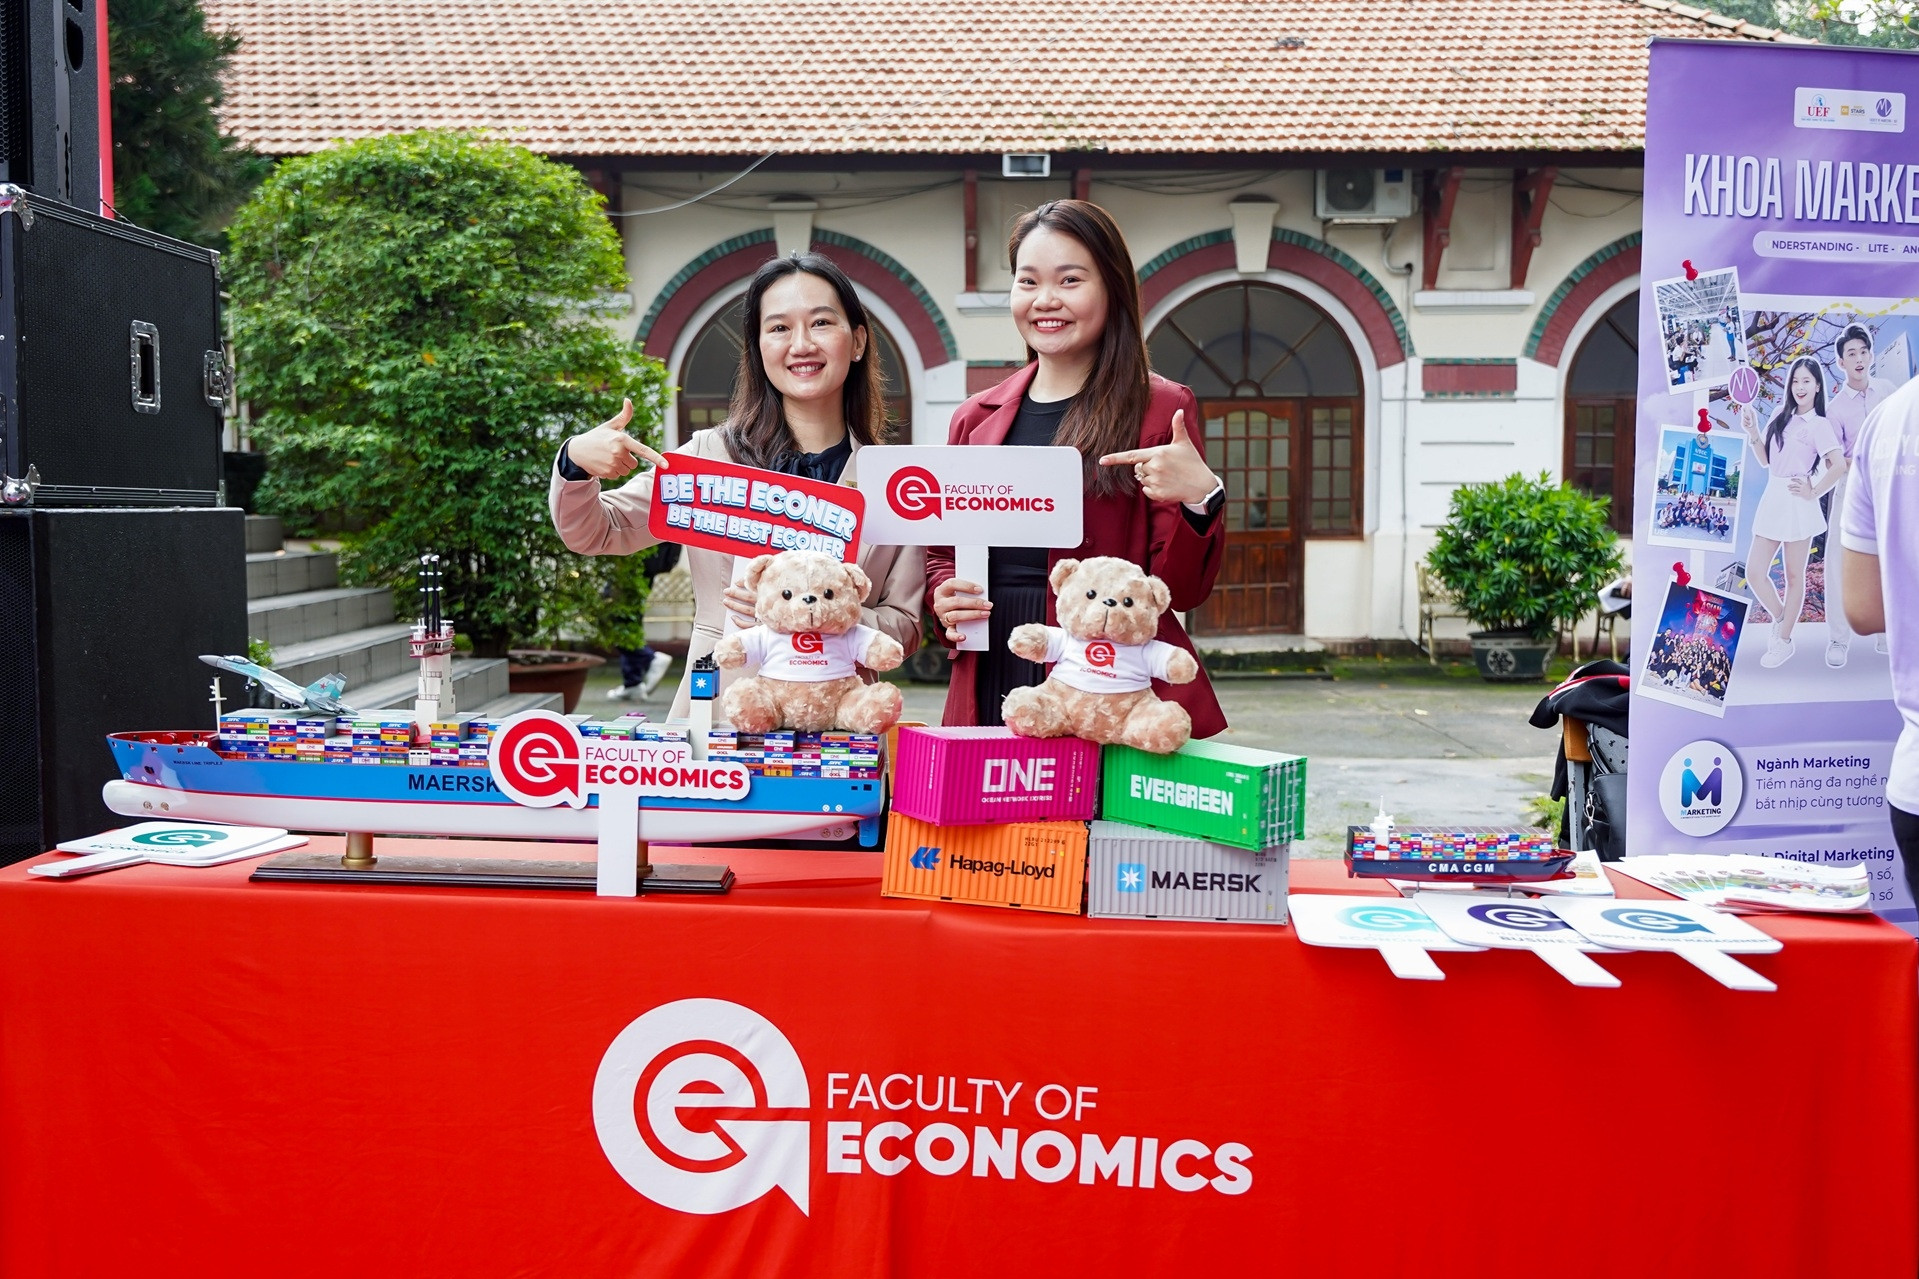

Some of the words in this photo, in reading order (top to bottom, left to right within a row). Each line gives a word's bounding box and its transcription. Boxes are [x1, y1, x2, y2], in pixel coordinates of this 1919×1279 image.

[1808, 106, 1830, 117] UEF
[1683, 153, 1784, 219] KHOA
[945, 484, 994, 495] FACULTY
[997, 485, 1014, 495] OF
[660, 473, 694, 503] BE
[697, 474, 748, 507] THE
[750, 480, 857, 542] ECONER
[946, 497, 1055, 512] ECONOMICS
[666, 504, 692, 528] BE
[692, 508, 728, 536] THE
[727, 516, 772, 545] BEST
[771, 525, 846, 562] ECONER
[586, 747, 658, 763] FACULTY
[662, 750, 686, 764] OF
[1756, 757, 1799, 772] Ngành
[1803, 755, 1870, 770] Marketing
[408, 774, 503, 795] MAERSK
[585, 764, 744, 790] ECONOMICS
[982, 758, 1056, 792] ONE
[1756, 777, 1786, 790] Tiềm
[1790, 777, 1822, 791] năng
[1825, 776, 1841, 788] đa
[1846, 774, 1878, 788] nghề
[1130, 774, 1234, 816] EVERGREEN
[1755, 798, 1776, 810] bắt
[1778, 796, 1806, 813] nhịp
[1810, 796, 1843, 810] cùng
[1680, 808, 1722, 816] MARKETING
[1774, 848, 1820, 863] Digital
[1824, 848, 1894, 864] Marketing
[950, 854, 1055, 880] Hapag-Lloyd
[1428, 863, 1460, 873] CMA
[1464, 863, 1494, 873] CGM
[1152, 870, 1262, 892] MAERSK
[1879, 888, 1894, 900] số
[827, 1073, 1024, 1117] FACULTY
[1034, 1084, 1099, 1122] OF
[826, 1120, 1255, 1196] ECONOMICS
